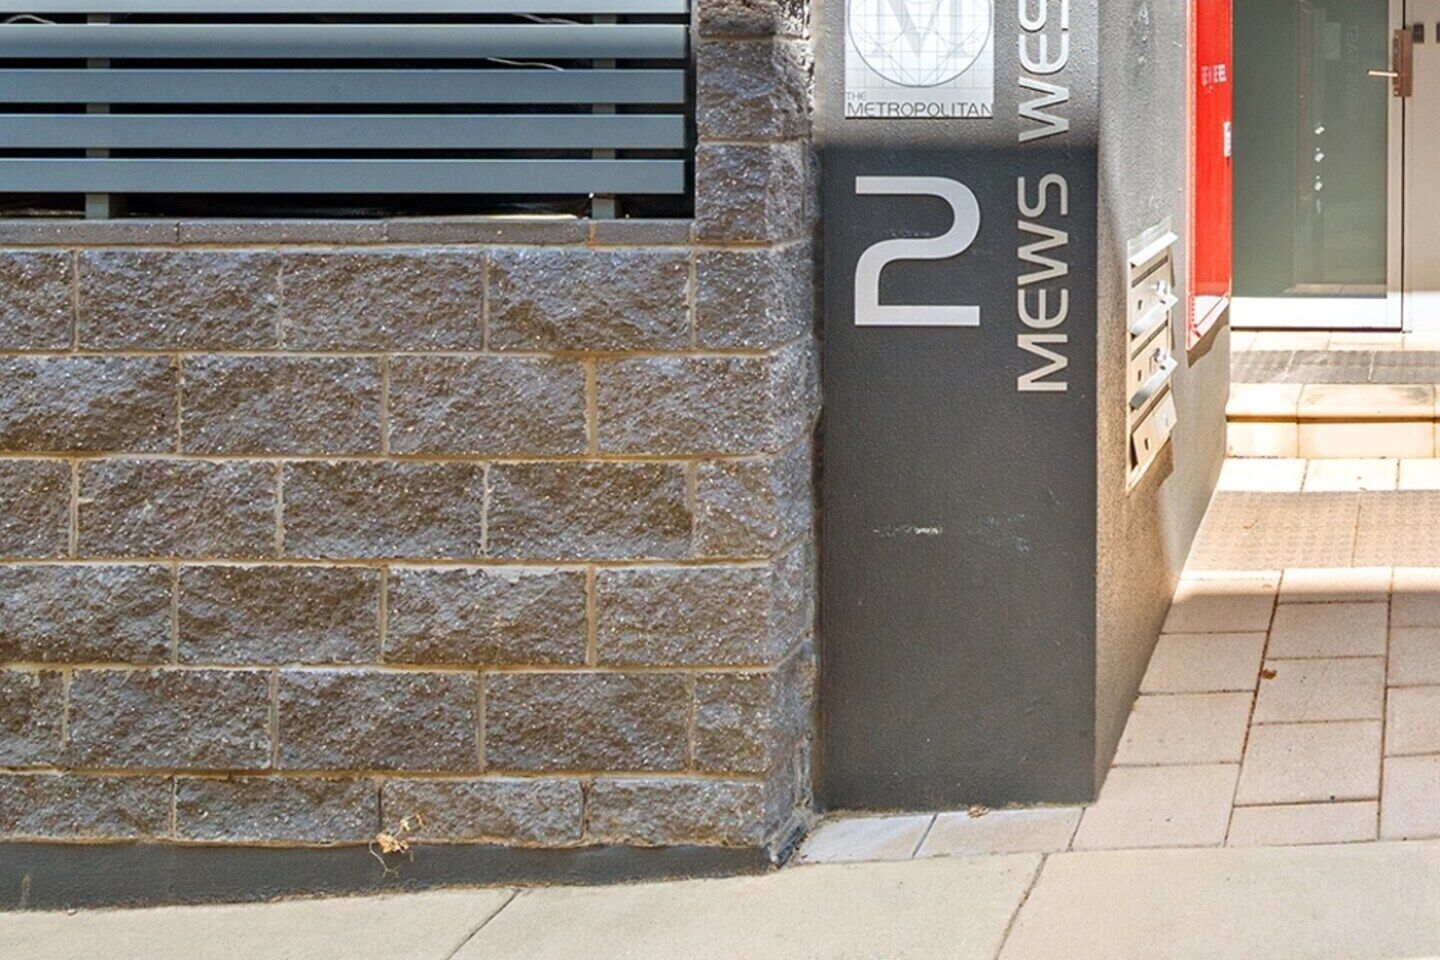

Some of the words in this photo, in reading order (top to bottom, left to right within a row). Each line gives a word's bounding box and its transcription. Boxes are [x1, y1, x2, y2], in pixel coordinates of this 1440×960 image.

[846, 91, 867, 101] THE
[847, 101, 994, 117] METROPOLITAN
[855, 175, 981, 326] 2
[1017, 172, 1069, 392] MEWS
